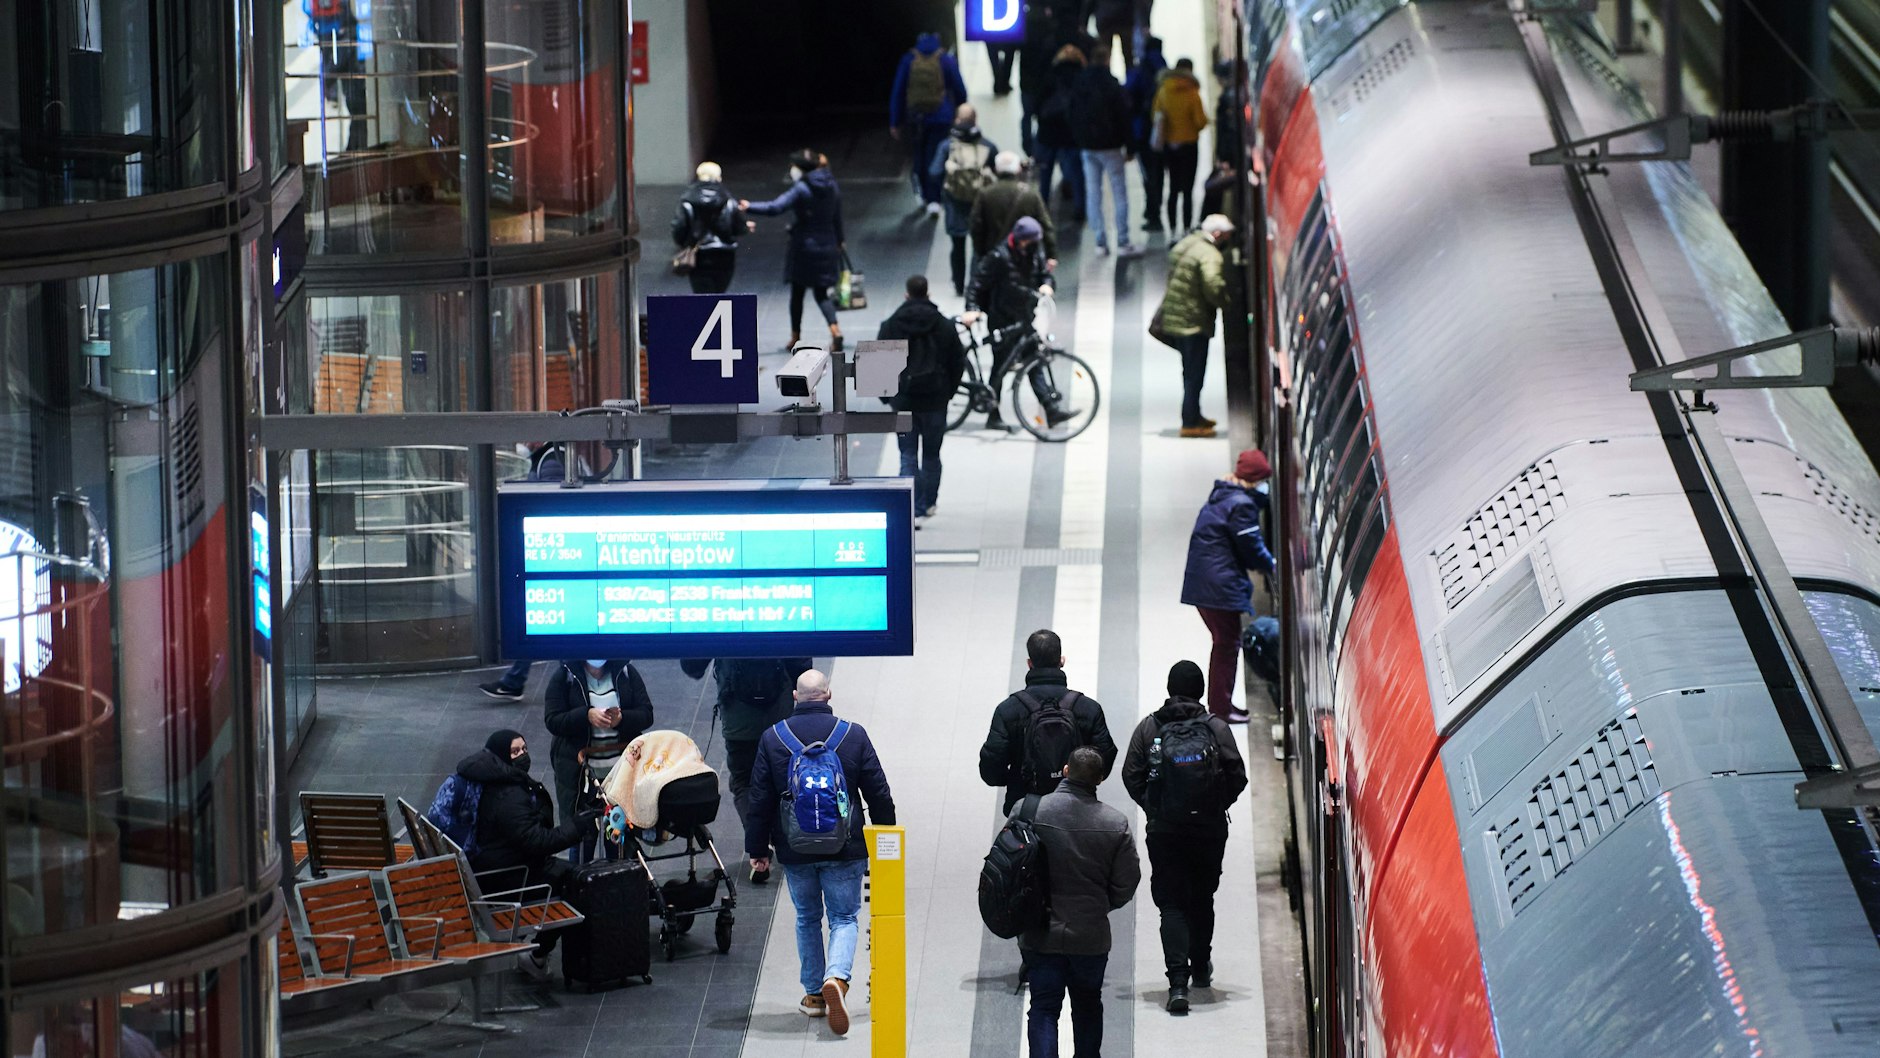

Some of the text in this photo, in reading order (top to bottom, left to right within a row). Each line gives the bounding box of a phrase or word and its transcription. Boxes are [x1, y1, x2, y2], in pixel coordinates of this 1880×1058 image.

[982, 0, 1020, 31] D
[691, 300, 742, 378] 4
[525, 533, 565, 548] 05:43
[525, 549, 538, 560] RE
[598, 544, 735, 569] Altentreptow
[712, 606, 754, 621] Erfurt
[788, 606, 797, 620] /
